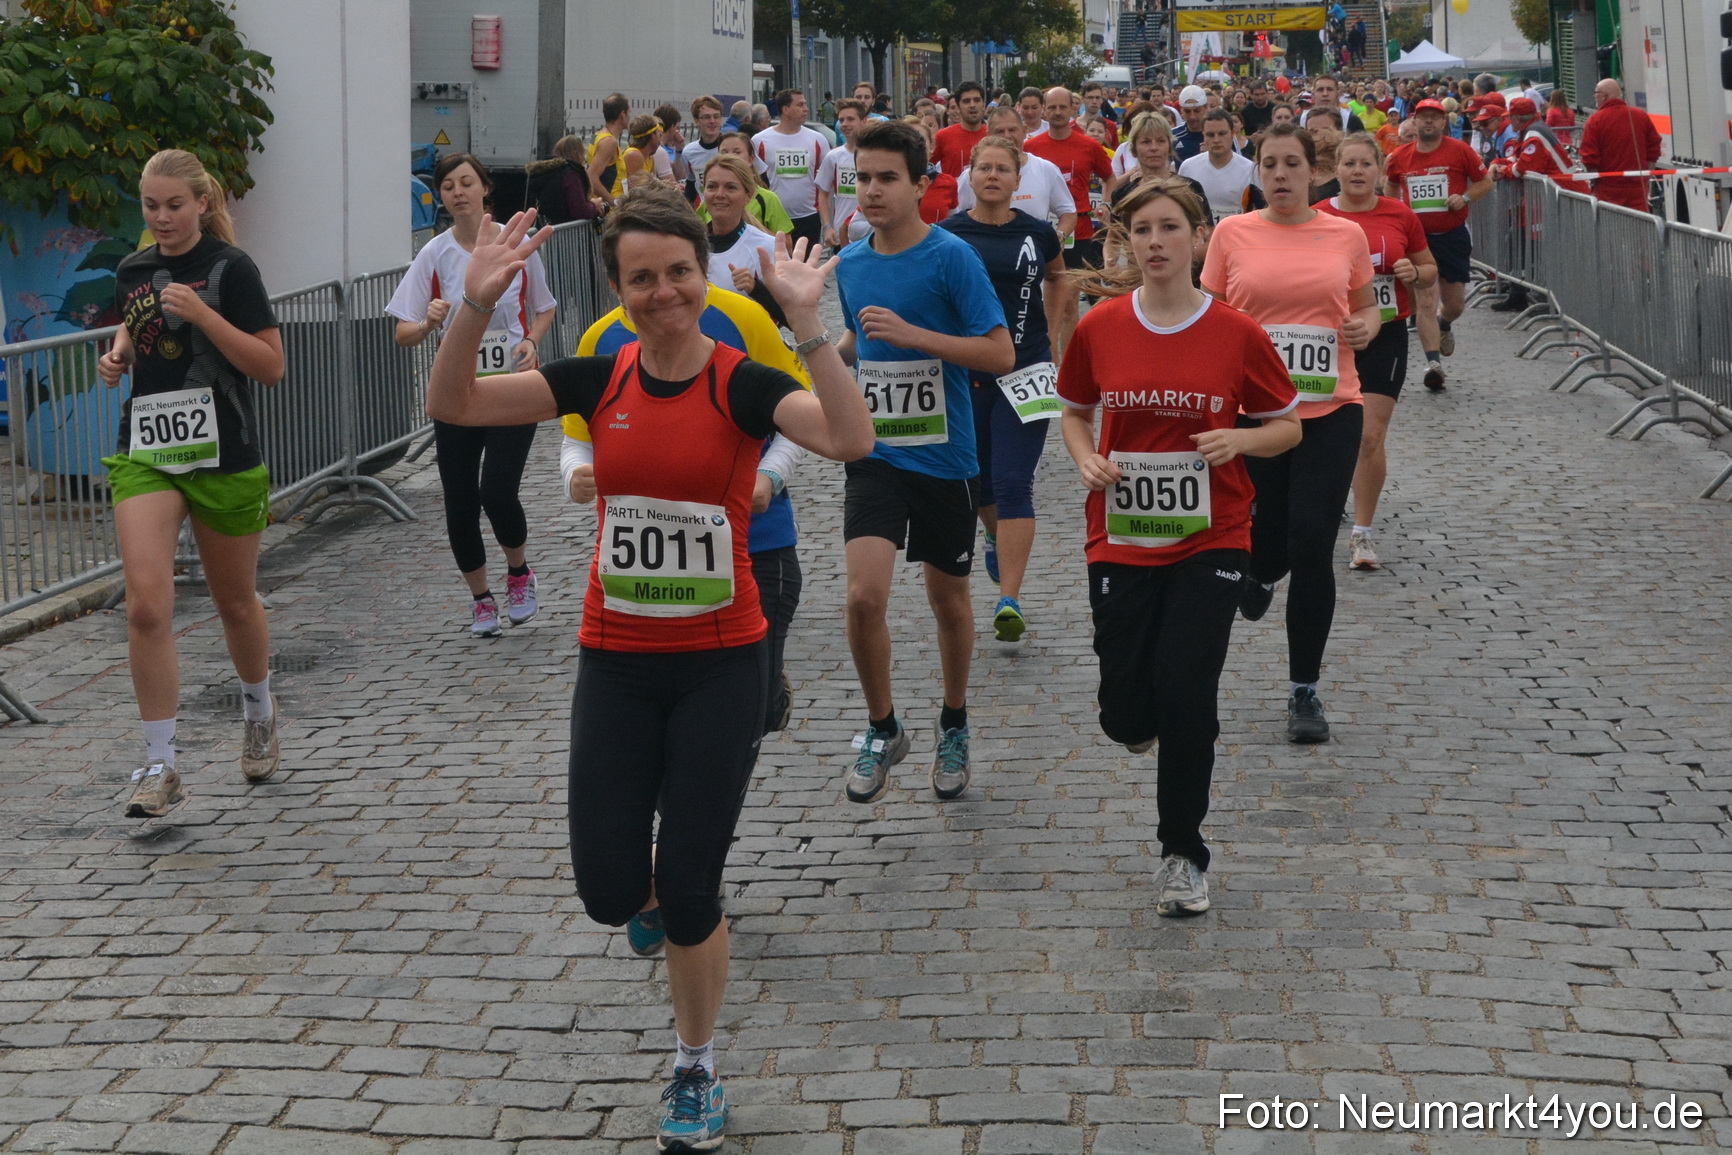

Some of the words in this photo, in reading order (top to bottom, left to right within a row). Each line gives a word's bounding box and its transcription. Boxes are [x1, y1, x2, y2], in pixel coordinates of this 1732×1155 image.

[713, 0, 746, 38] BOCK
[1225, 13, 1276, 26] START
[778, 155, 806, 166] 5191
[841, 172, 856, 185] 52
[1412, 184, 1443, 199] 5551
[125, 293, 155, 327] orld
[131, 309, 156, 343] hampion
[138, 317, 163, 355] 2007
[1269, 331, 1285, 339] RTL
[1287, 331, 1325, 342] Neumarkt
[478, 346, 505, 369] 19
[1274, 342, 1331, 373] 109
[860, 369, 882, 378] PARTL
[883, 369, 925, 379] Neumarkt
[1293, 379, 1322, 391] abeth
[133, 403, 155, 413] PARTL
[156, 397, 198, 410] Neumarkt
[864, 381, 936, 413] 5176
[1101, 390, 1206, 410] NEUMARKT
[1040, 401, 1058, 410] Jana
[139, 409, 209, 446] 5062
[609, 422, 630, 430] erima
[873, 423, 928, 435] ohannes
[152, 450, 197, 464] Theresa
[1112, 461, 1137, 471] RTL
[1139, 461, 1189, 472] Neumarkt
[1115, 476, 1199, 511] 5050
[607, 506, 644, 520] PARTL
[647, 508, 707, 526] Neumarkt
[1130, 519, 1184, 535] Melanie
[611, 525, 715, 572] 5011
[1216, 568, 1237, 581] JAKO
[634, 582, 695, 600] Marion
